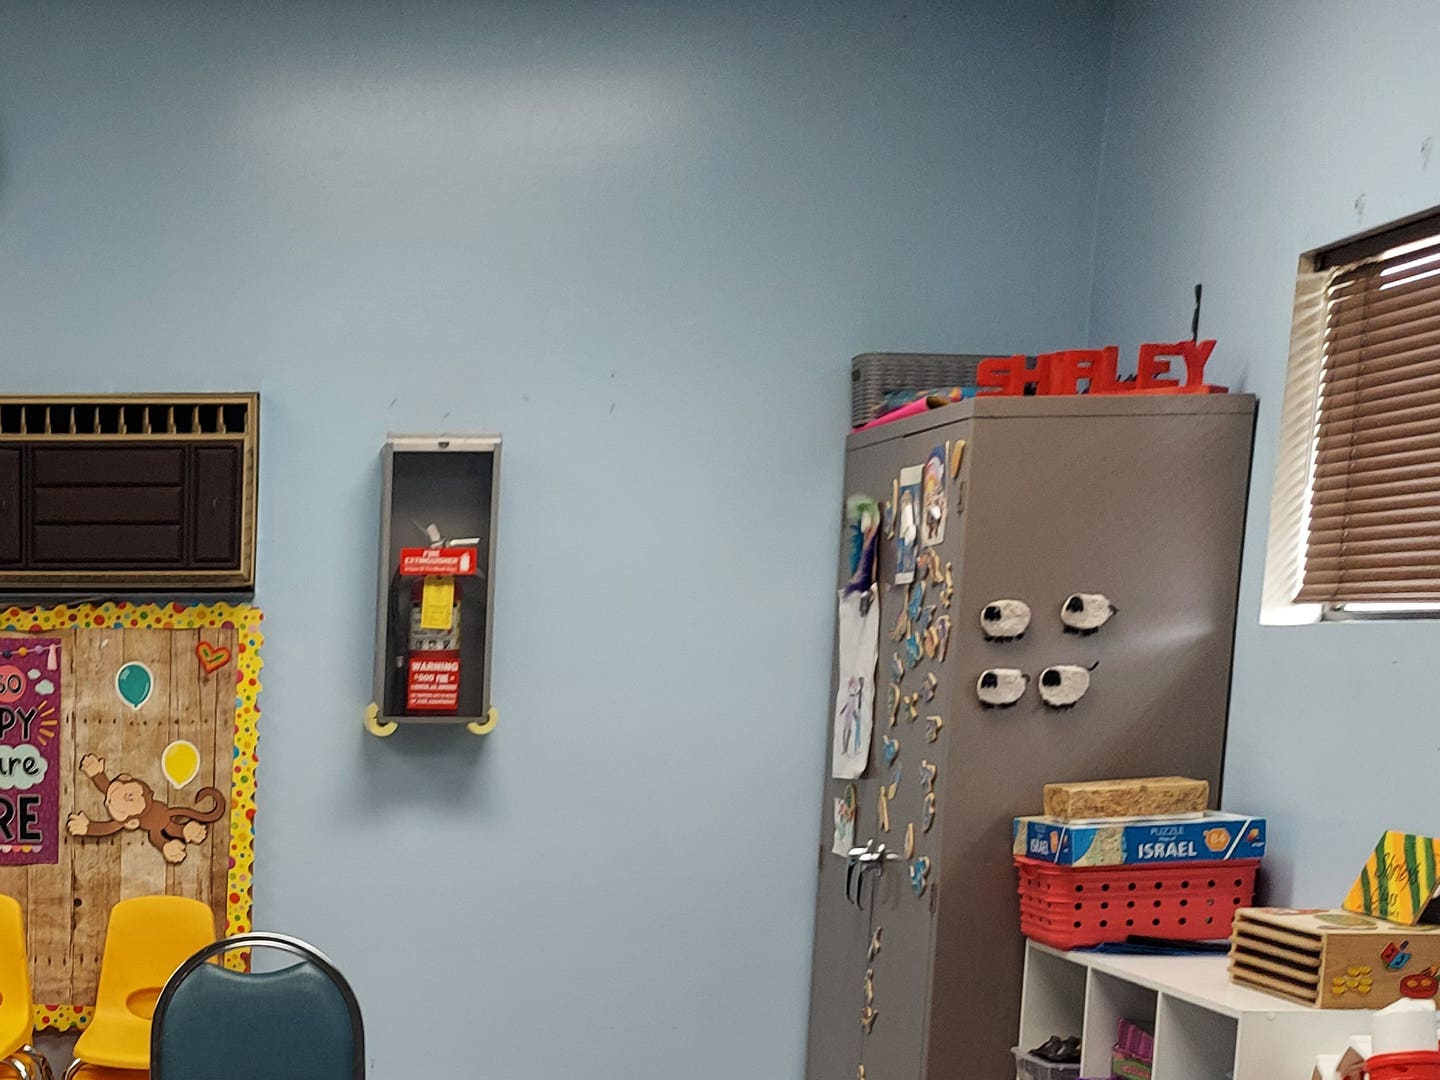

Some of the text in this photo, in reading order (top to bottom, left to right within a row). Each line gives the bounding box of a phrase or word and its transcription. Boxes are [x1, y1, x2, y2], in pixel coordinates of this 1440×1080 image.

[411, 661, 459, 672] WARNING
[1150, 826, 1184, 837] PUZZLE
[1137, 841, 1198, 860] ISRAEL
